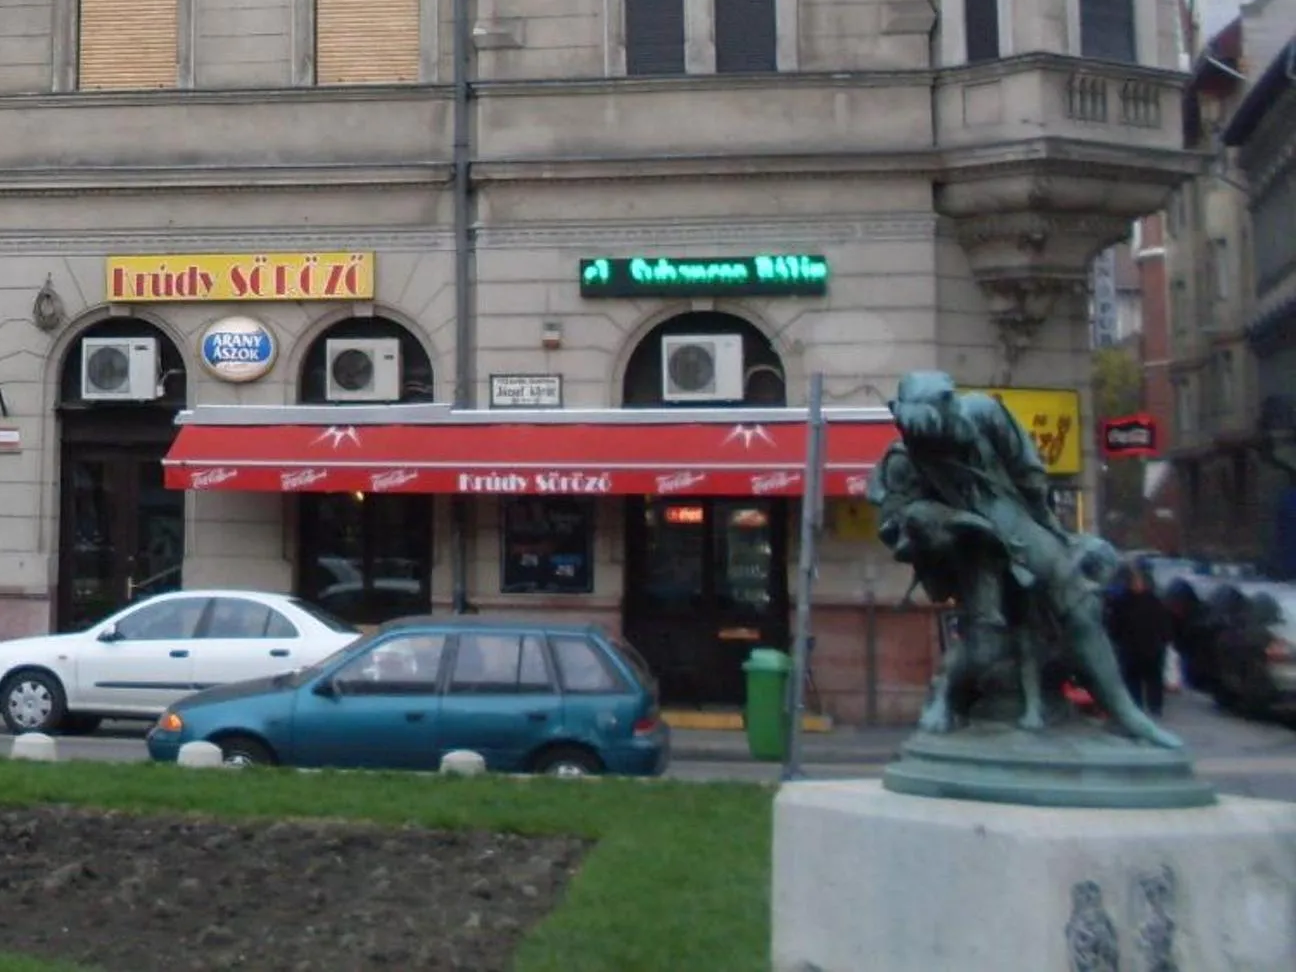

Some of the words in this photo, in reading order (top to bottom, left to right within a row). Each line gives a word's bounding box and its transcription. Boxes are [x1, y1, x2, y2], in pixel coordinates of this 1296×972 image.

[113, 263, 218, 297] Krúdy
[212, 333, 262, 348] ARANY
[458, 472, 528, 492] Krúdy
